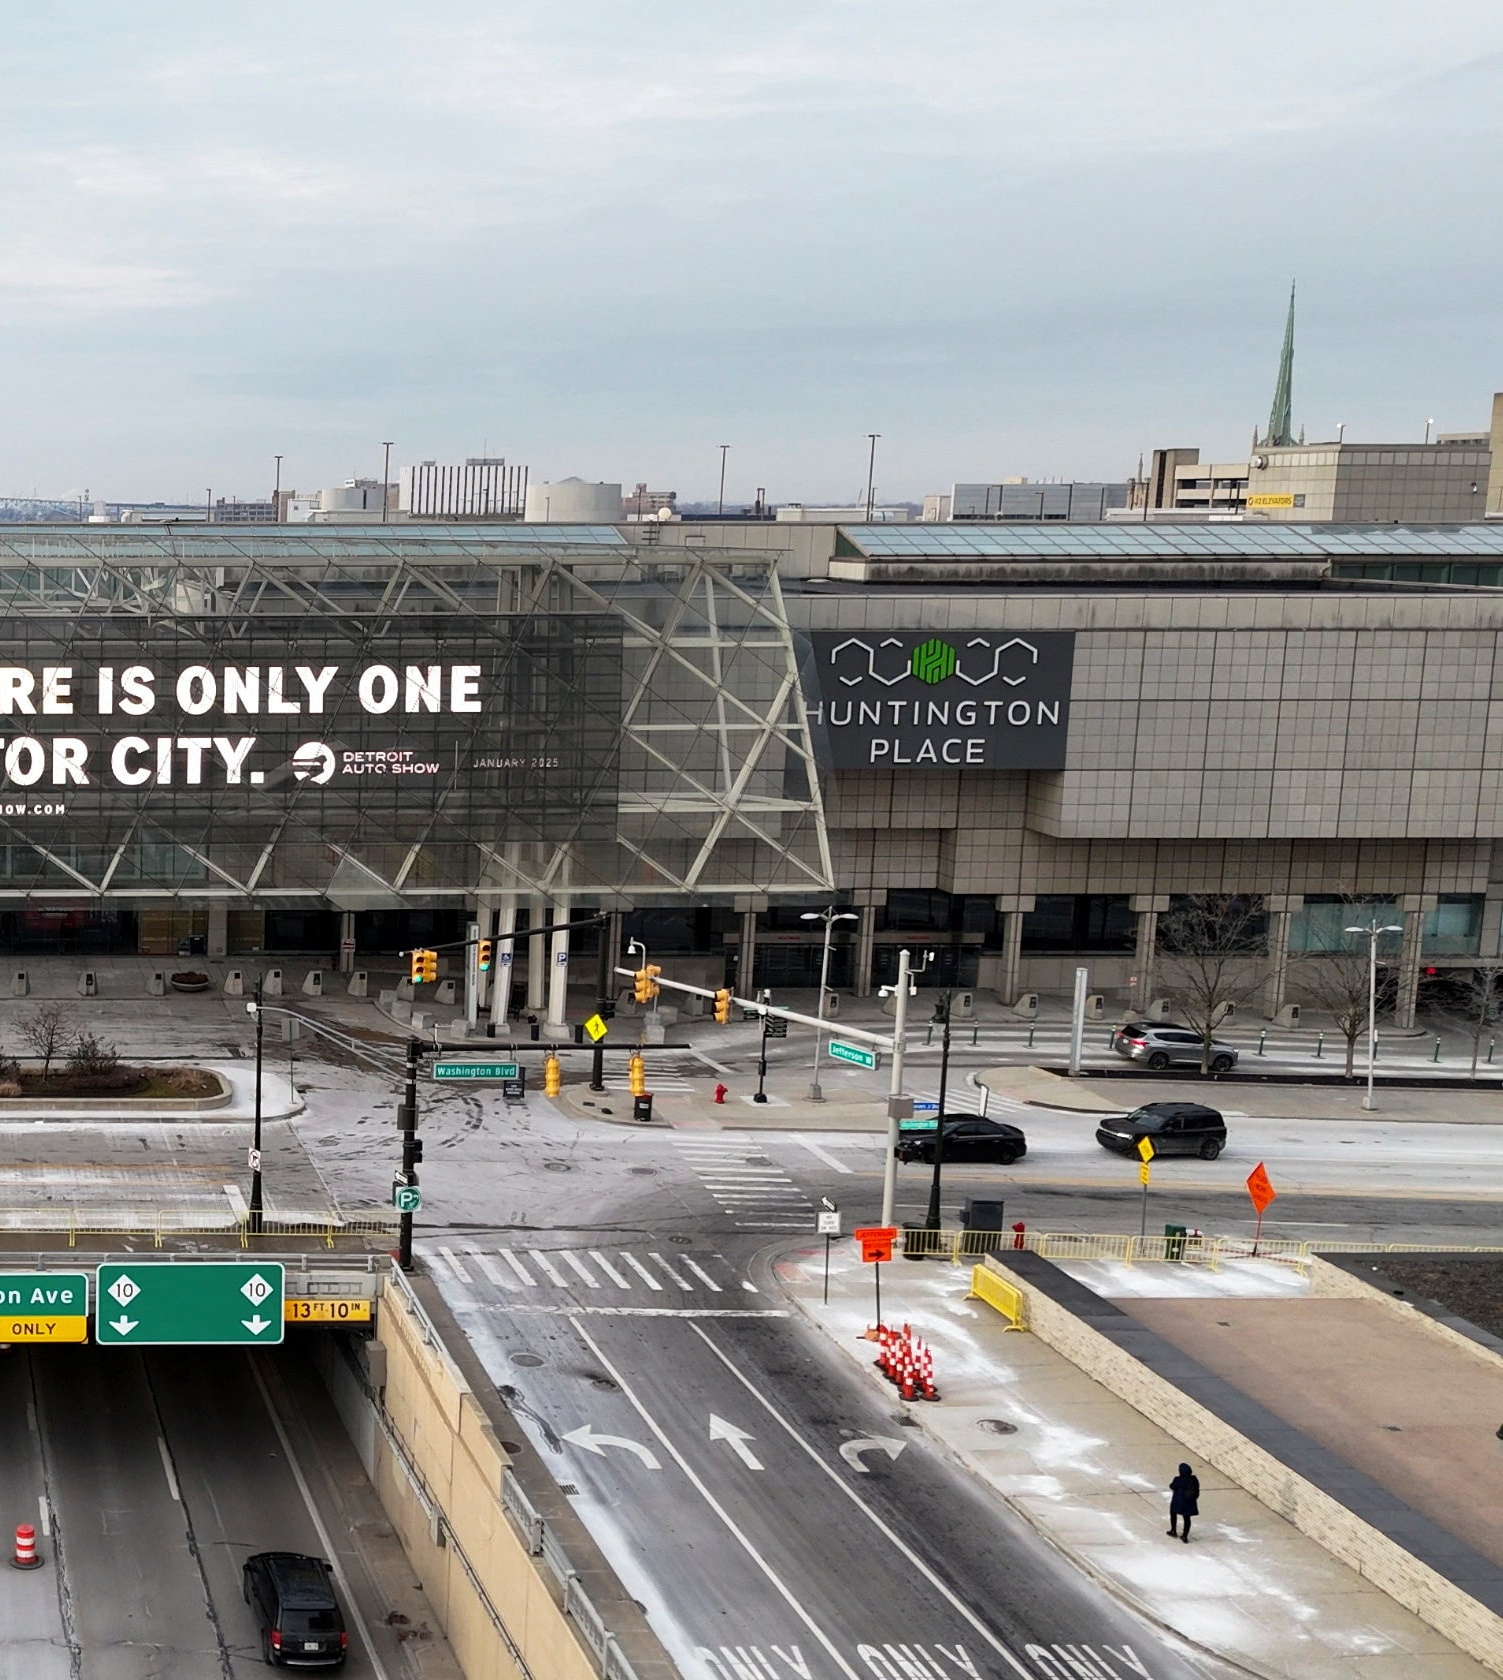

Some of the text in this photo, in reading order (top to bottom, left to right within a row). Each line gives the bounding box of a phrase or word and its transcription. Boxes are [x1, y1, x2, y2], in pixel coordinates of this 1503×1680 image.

[98, 665, 156, 716] IS
[176, 665, 339, 716] ONLY
[358, 665, 482, 714] ONE
[343, 751, 413, 762] DETROIT
[870, 739, 986, 764] PLACE
[111, 736, 265, 786] CITY.
[342, 763, 440, 774] AUTO SHOW
[473, 757, 559, 768] JANUARY 2025
[437, 1066, 515, 1078] Washington Blvd
[400, 1191, 413, 1208] P
[30, 1288, 74, 1304] Ave
[116, 1283, 133, 1298] 10
[249, 1282, 266, 1298] 10
[293, 1303, 310, 1319] 13
[330, 1303, 348, 1319] 10
[351, 1303, 361, 1312] IN
[12, 1323, 56, 1335] ONLY
